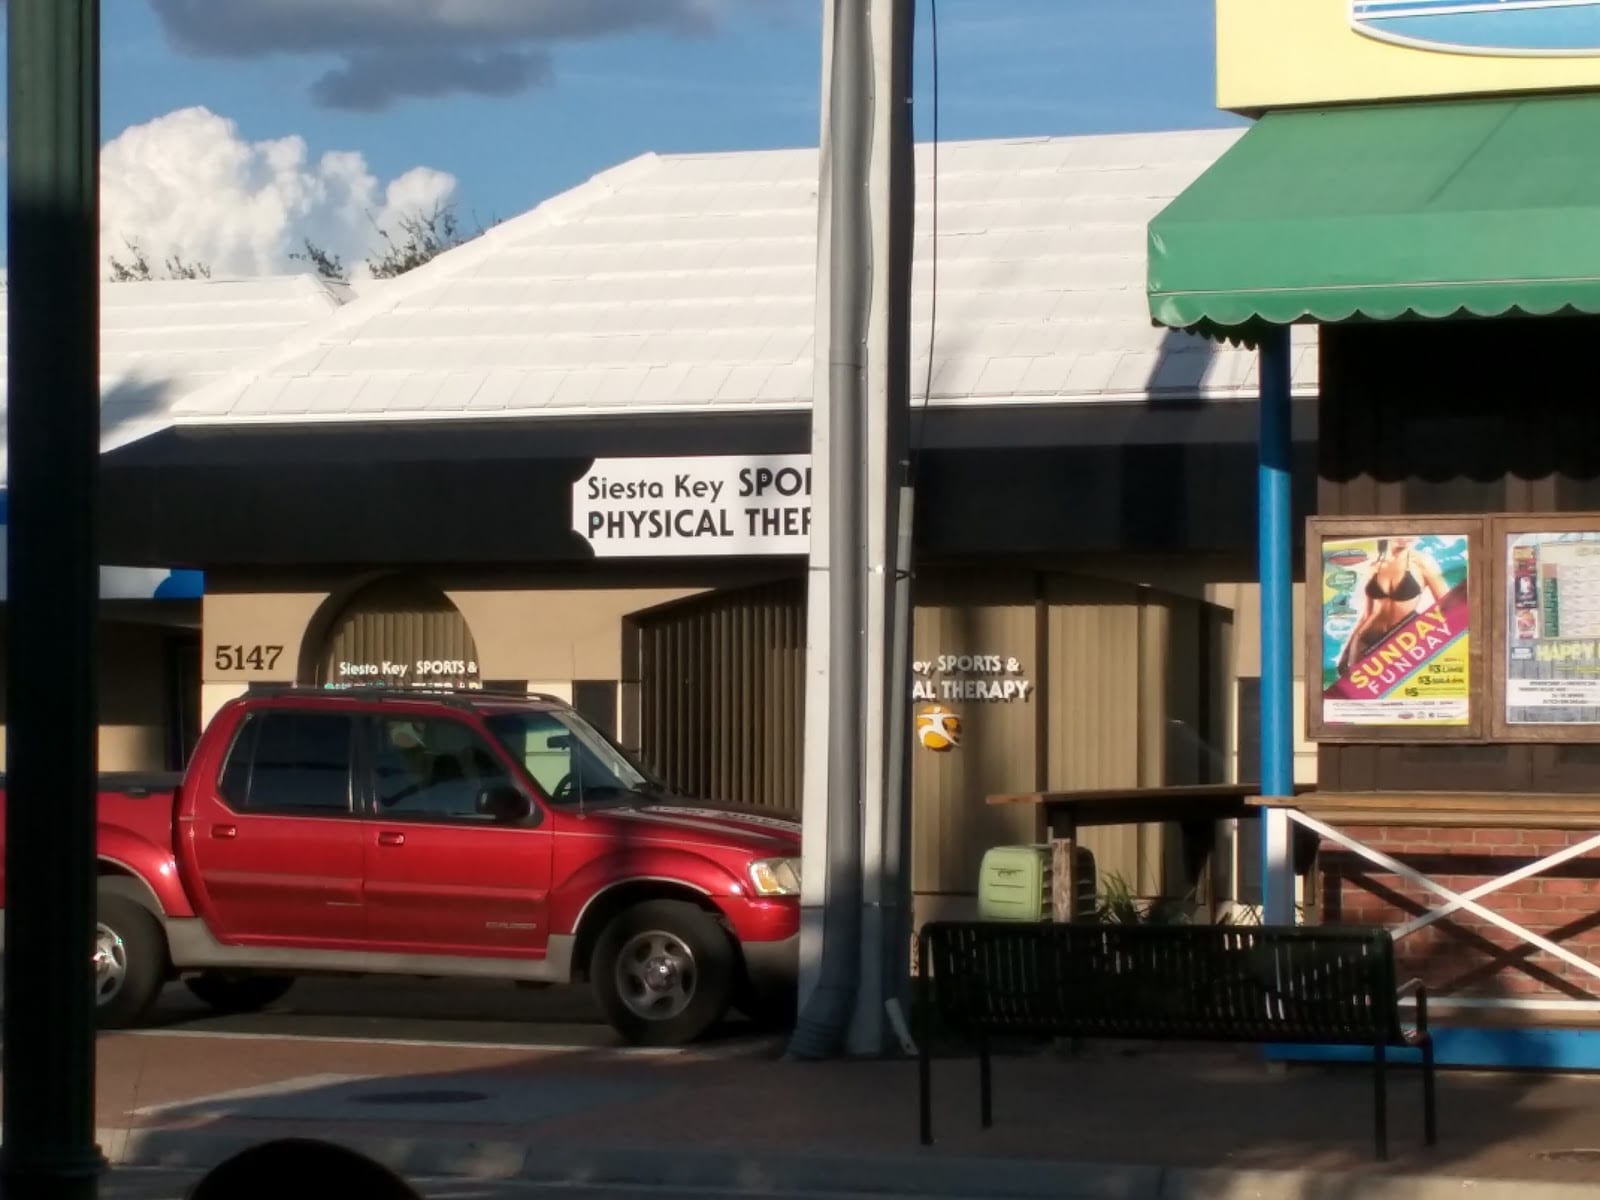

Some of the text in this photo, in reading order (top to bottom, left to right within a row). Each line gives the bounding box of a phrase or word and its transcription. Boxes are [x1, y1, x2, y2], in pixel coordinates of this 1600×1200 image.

[588, 467, 812, 503] Siesta Key SPO
[587, 508, 734, 539] PHYSICAL
[214, 645, 284, 671] 5147
[1350, 605, 1448, 690] SUNDAY
[1367, 622, 1453, 695] FUNDAY
[339, 660, 478, 677] Siesta Key SPORTS &
[937, 655, 1002, 672] SPORTS
[1006, 657, 1020, 672] &
[941, 680, 1030, 699] THERAPY
